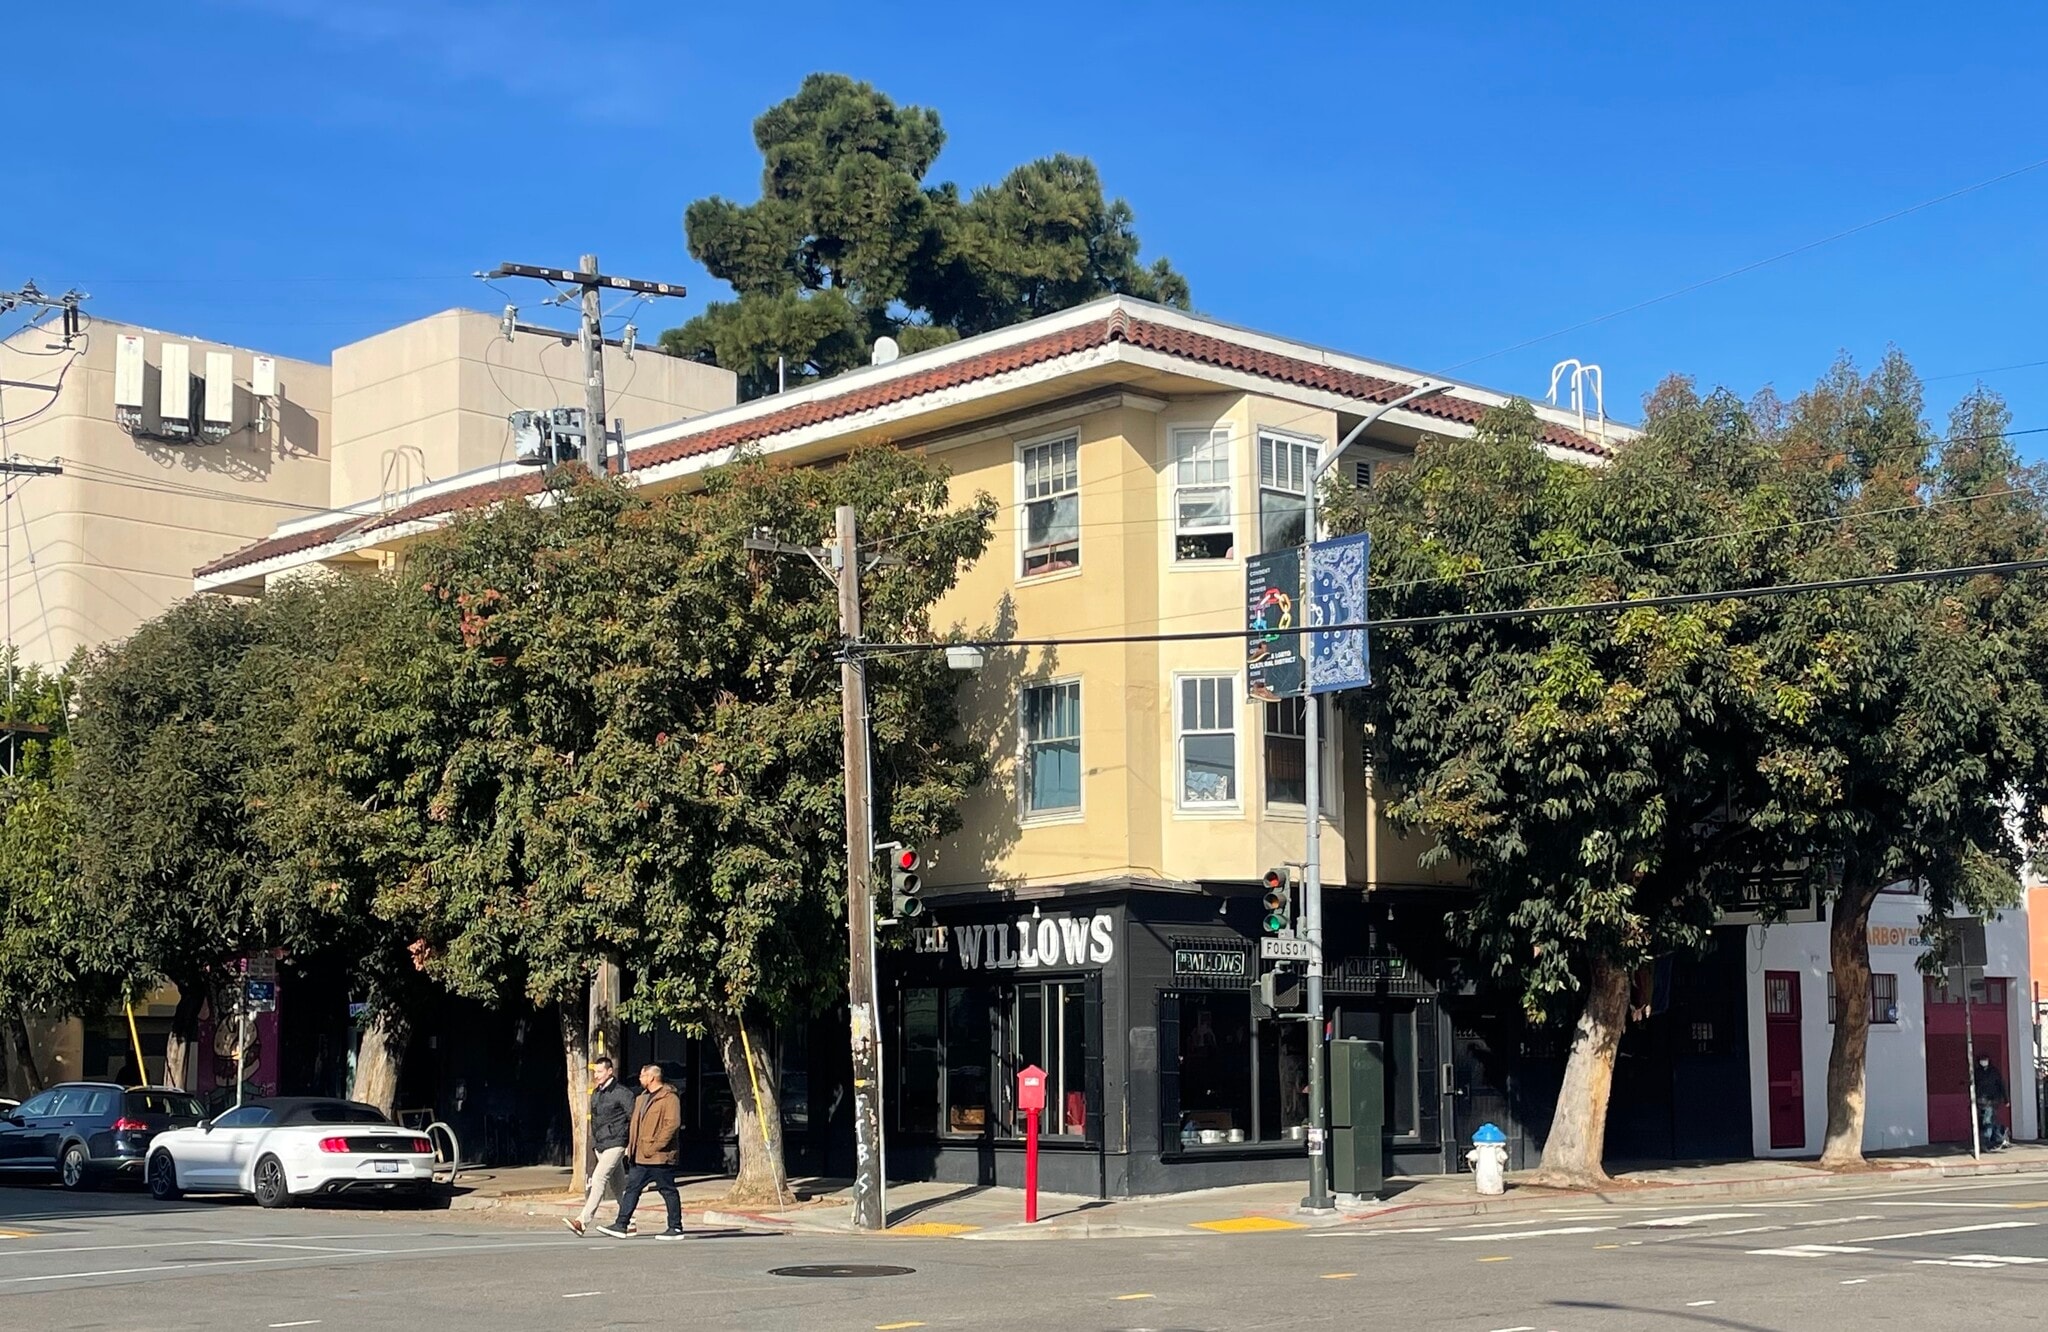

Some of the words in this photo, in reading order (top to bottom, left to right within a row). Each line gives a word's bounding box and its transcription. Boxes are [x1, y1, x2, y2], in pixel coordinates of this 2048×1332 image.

[913, 926, 949, 953] THE
[954, 915, 1114, 969] WILLOWS
[1266, 942, 1307, 955] FOLSOM
[1188, 953, 1242, 972] WILLOWS
